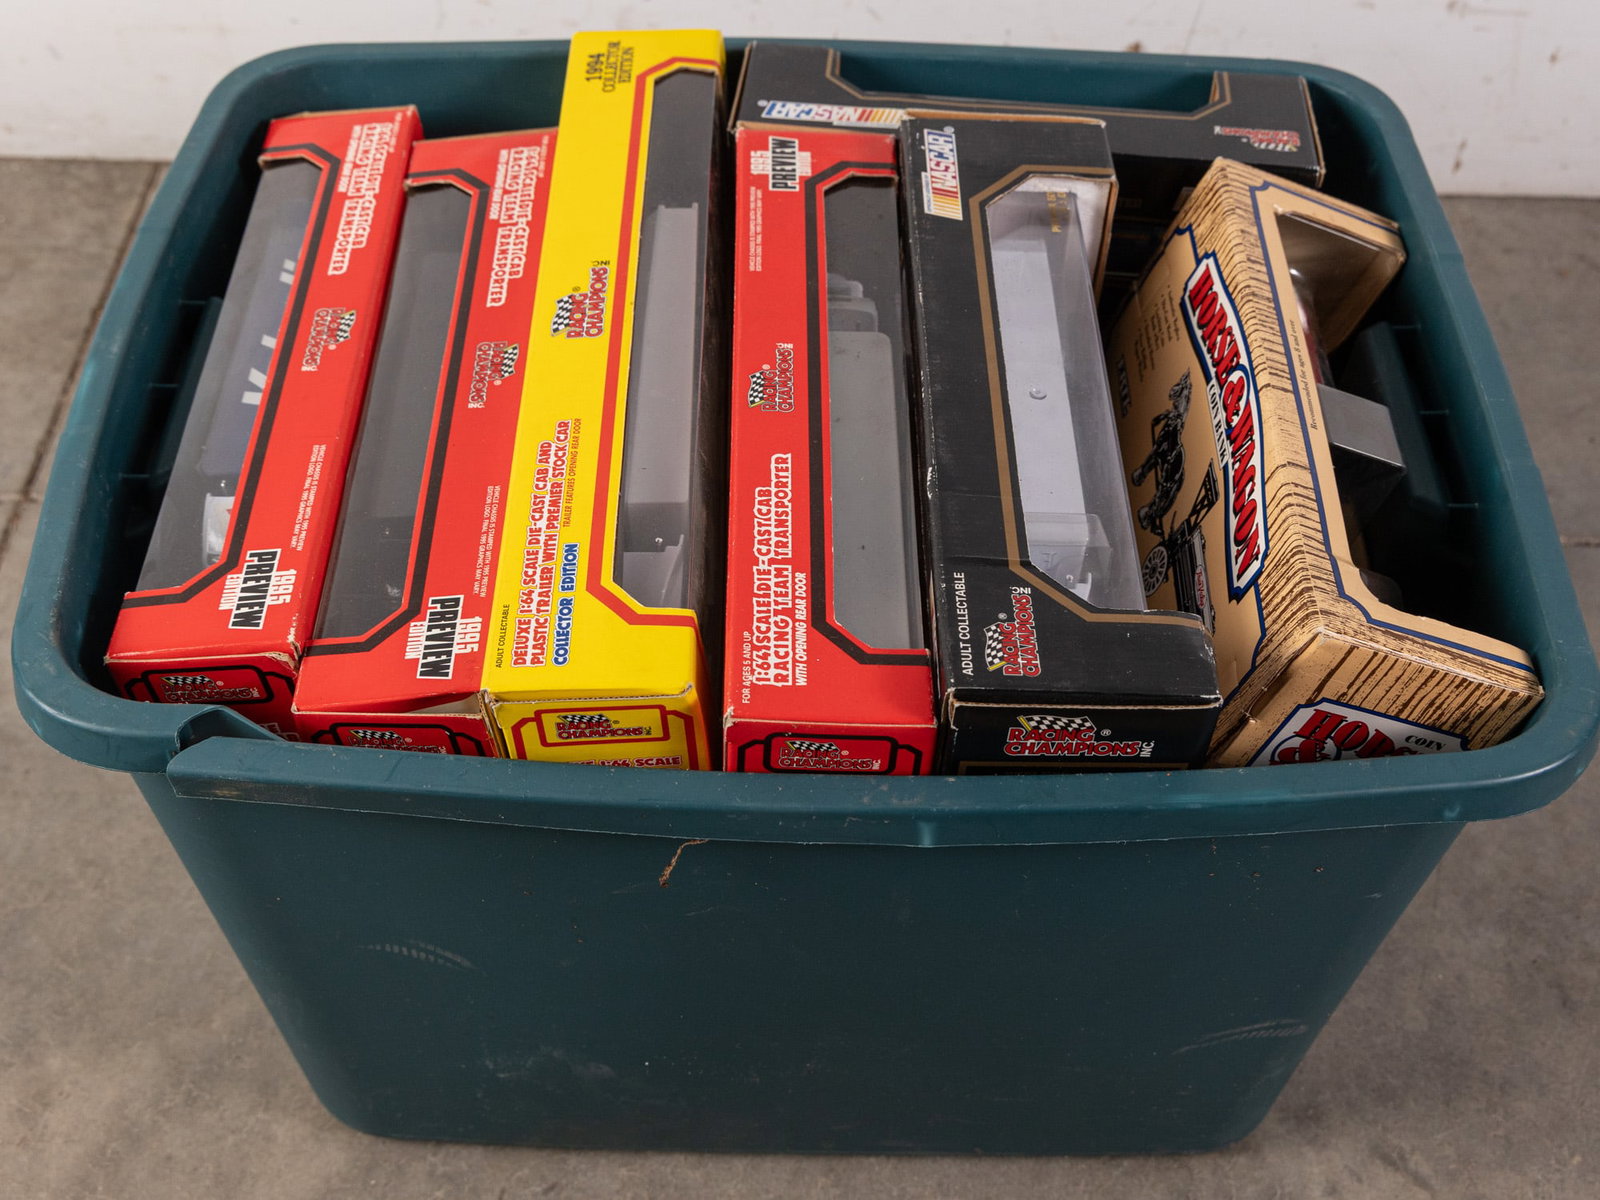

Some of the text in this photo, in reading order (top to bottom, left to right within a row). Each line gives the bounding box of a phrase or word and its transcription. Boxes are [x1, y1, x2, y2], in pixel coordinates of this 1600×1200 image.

[585, 53, 604, 81] 1994
[602, 40, 620, 92] COLLECTOR
[618, 46, 634, 83] EDITION
[761, 100, 860, 122] NASCAR
[768, 136, 799, 192] PREVIEW
[924, 129, 959, 191] NASCAR
[328, 198, 361, 275] TRANSPORTER
[486, 148, 526, 307] RACING TEAM TRANSPORTER
[508, 253, 526, 279] CAB
[585, 267, 609, 337] CHAMPIONS
[1188, 264, 1260, 582] HORSE & WAGON
[1208, 384, 1228, 462] COIN BANK
[572, 436, 580, 450] REAR
[568, 450, 578, 477] OPENING
[566, 478, 575, 504] FEATURES
[562, 505, 572, 527] TRAILER
[512, 440, 553, 666] DELUXE 1:64 SCALE DIE-CAST CAB AND
[530, 419, 571, 666] PLASTIC TRAILER WITH PREMIER STOCK CAR
[228, 548, 281, 629] PREVIEW
[268, 568, 297, 605] 1995
[752, 487, 773, 686] 1:64 SCALE DIE-CAST CAB
[770, 453, 793, 686] RACING TEAM TRANSPORTER
[218, 574, 242, 610] EDITION
[552, 542, 580, 667] COLLECTOR EDITION
[404, 621, 428, 659] EDITION
[416, 594, 464, 680] PREVIEW
[454, 616, 482, 654] 1995
[496, 604, 510, 668] ADULT COLLECTABLE
[744, 632, 752, 642] UP
[795, 572, 807, 686] WITH OPENING REAR DOOR
[954, 572, 974, 676] ADULT COLLECTABLE
[1011, 594, 1041, 677] CHAMPIONS
[743, 644, 751, 659] AND
[999, 622, 1024, 676] RACING
[742, 666, 752, 686] AGES
[742, 688, 750, 704] FOR
[557, 727, 644, 740] CHAMPIONS
[1004, 741, 1141, 756] CHAMPIONS
[1007, 727, 1095, 742] RACING
[1405, 735, 1446, 751] COIN
[634, 756, 682, 766] SCALE
[778, 756, 873, 769] CHAMPIONS
